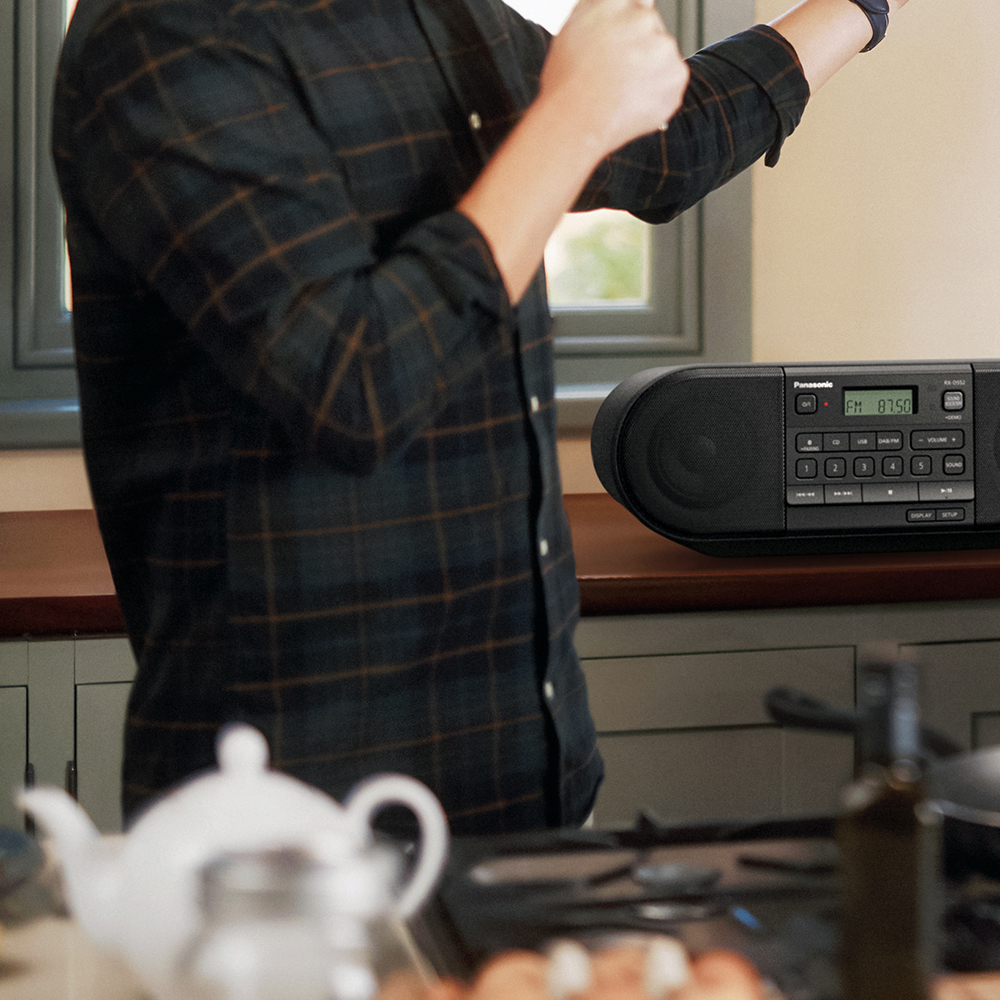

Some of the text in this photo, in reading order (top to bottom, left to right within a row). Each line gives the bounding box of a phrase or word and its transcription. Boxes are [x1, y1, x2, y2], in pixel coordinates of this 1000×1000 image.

[793, 381, 834, 389] Panasonic
[846, 400, 862, 413] FM
[833, 464, 838, 472] 2
[862, 463, 867, 471] 3
[890, 463, 896, 471] 4
[918, 462, 924, 470] 5
